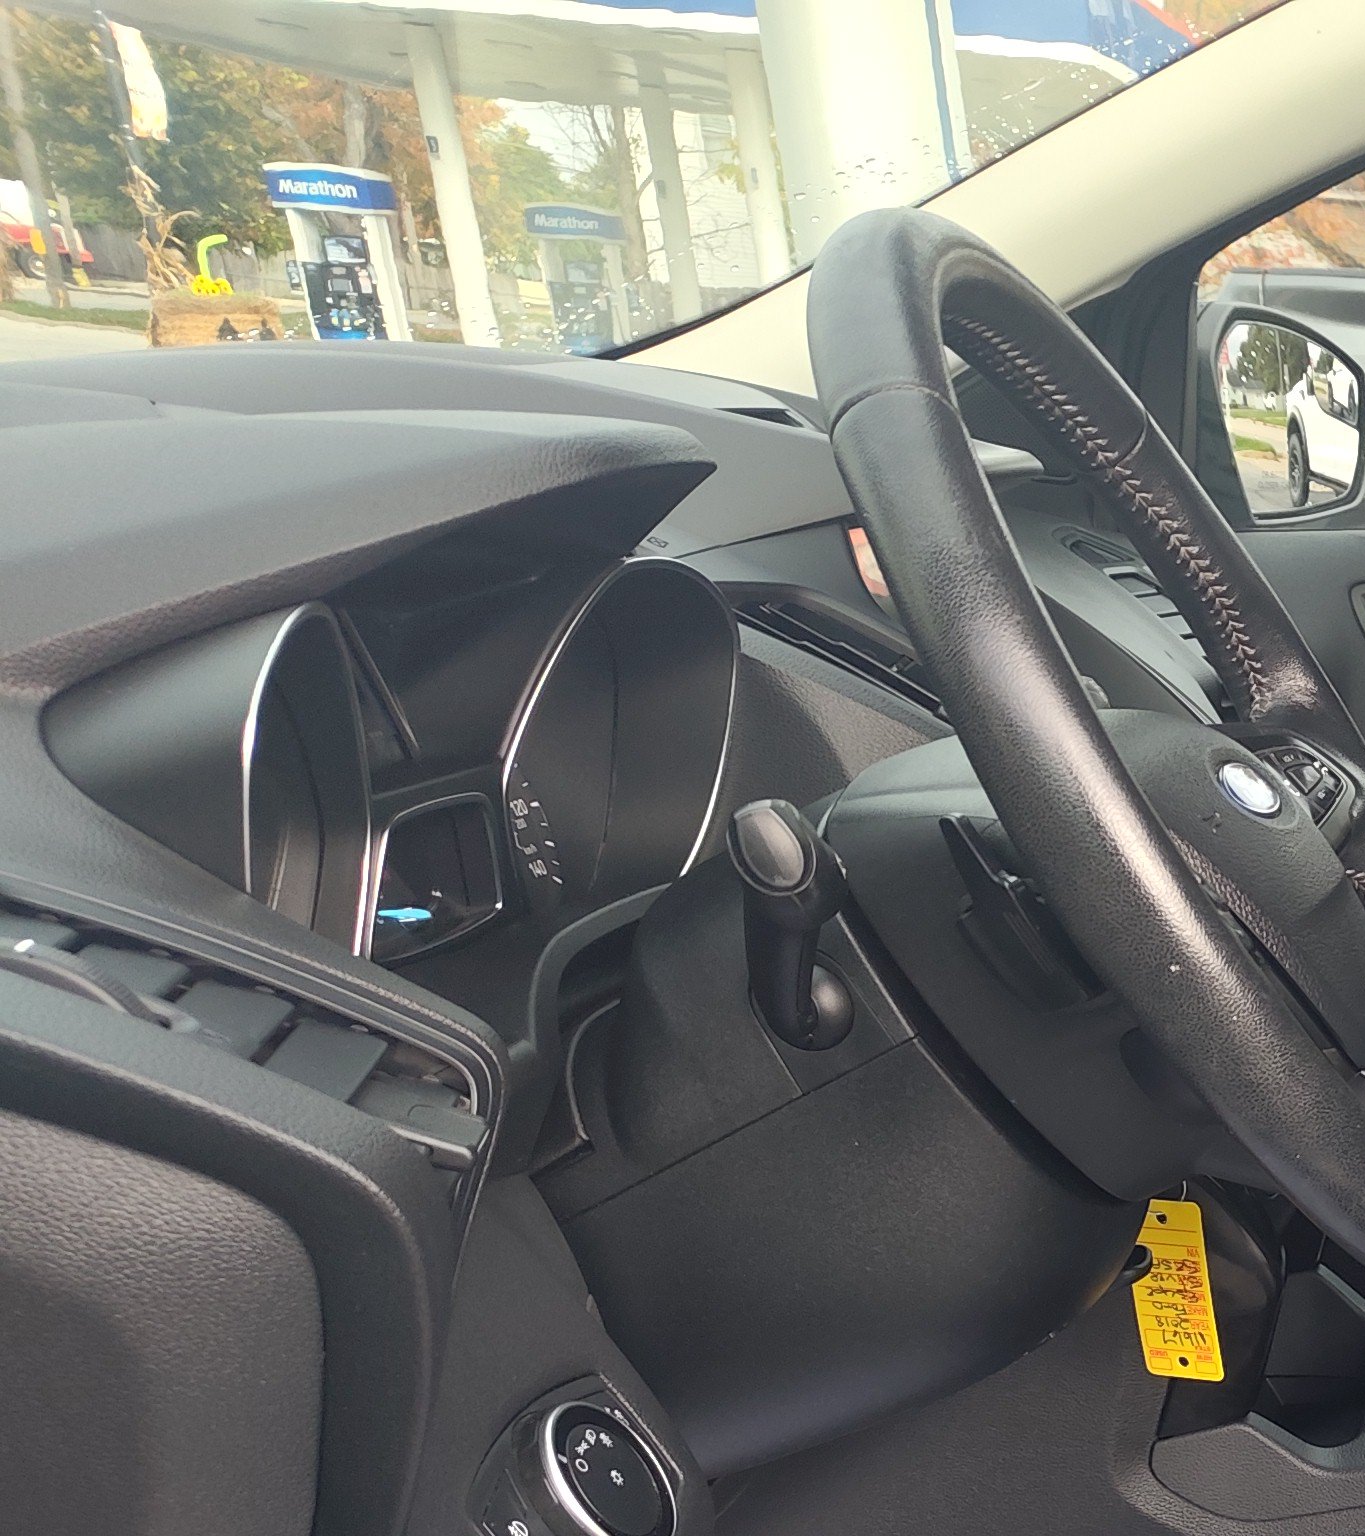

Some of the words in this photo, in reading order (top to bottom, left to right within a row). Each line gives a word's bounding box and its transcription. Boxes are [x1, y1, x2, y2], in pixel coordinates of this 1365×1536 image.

[278, 179, 358, 199] Marathon
[534, 213, 599, 230] Marathon
[510, 799, 529, 816] 120
[529, 860, 548, 877] 140
